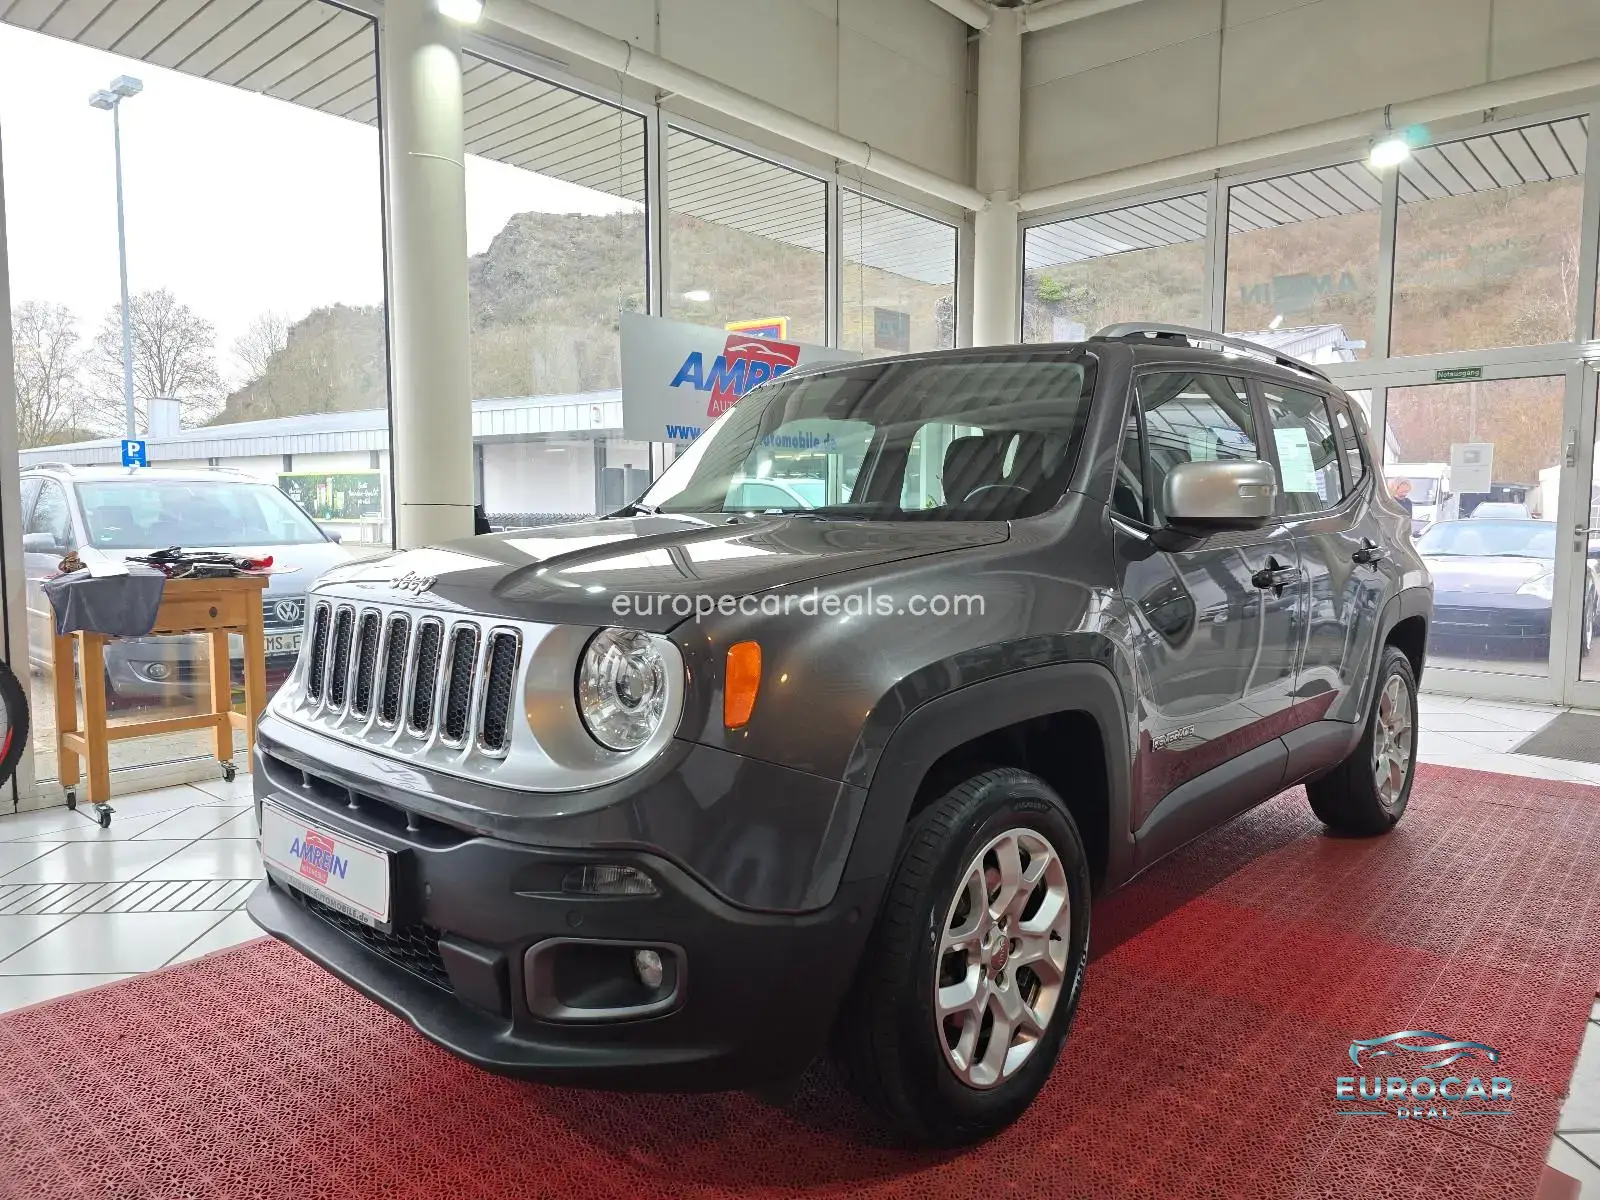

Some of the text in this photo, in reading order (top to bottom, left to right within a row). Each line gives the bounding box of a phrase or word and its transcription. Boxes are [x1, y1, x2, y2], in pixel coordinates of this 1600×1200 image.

[1437, 369, 1480, 379] Notausgang
[127, 441, 141, 457] P
[265, 636, 283, 651] MS
[289, 836, 348, 880] AMREIN
